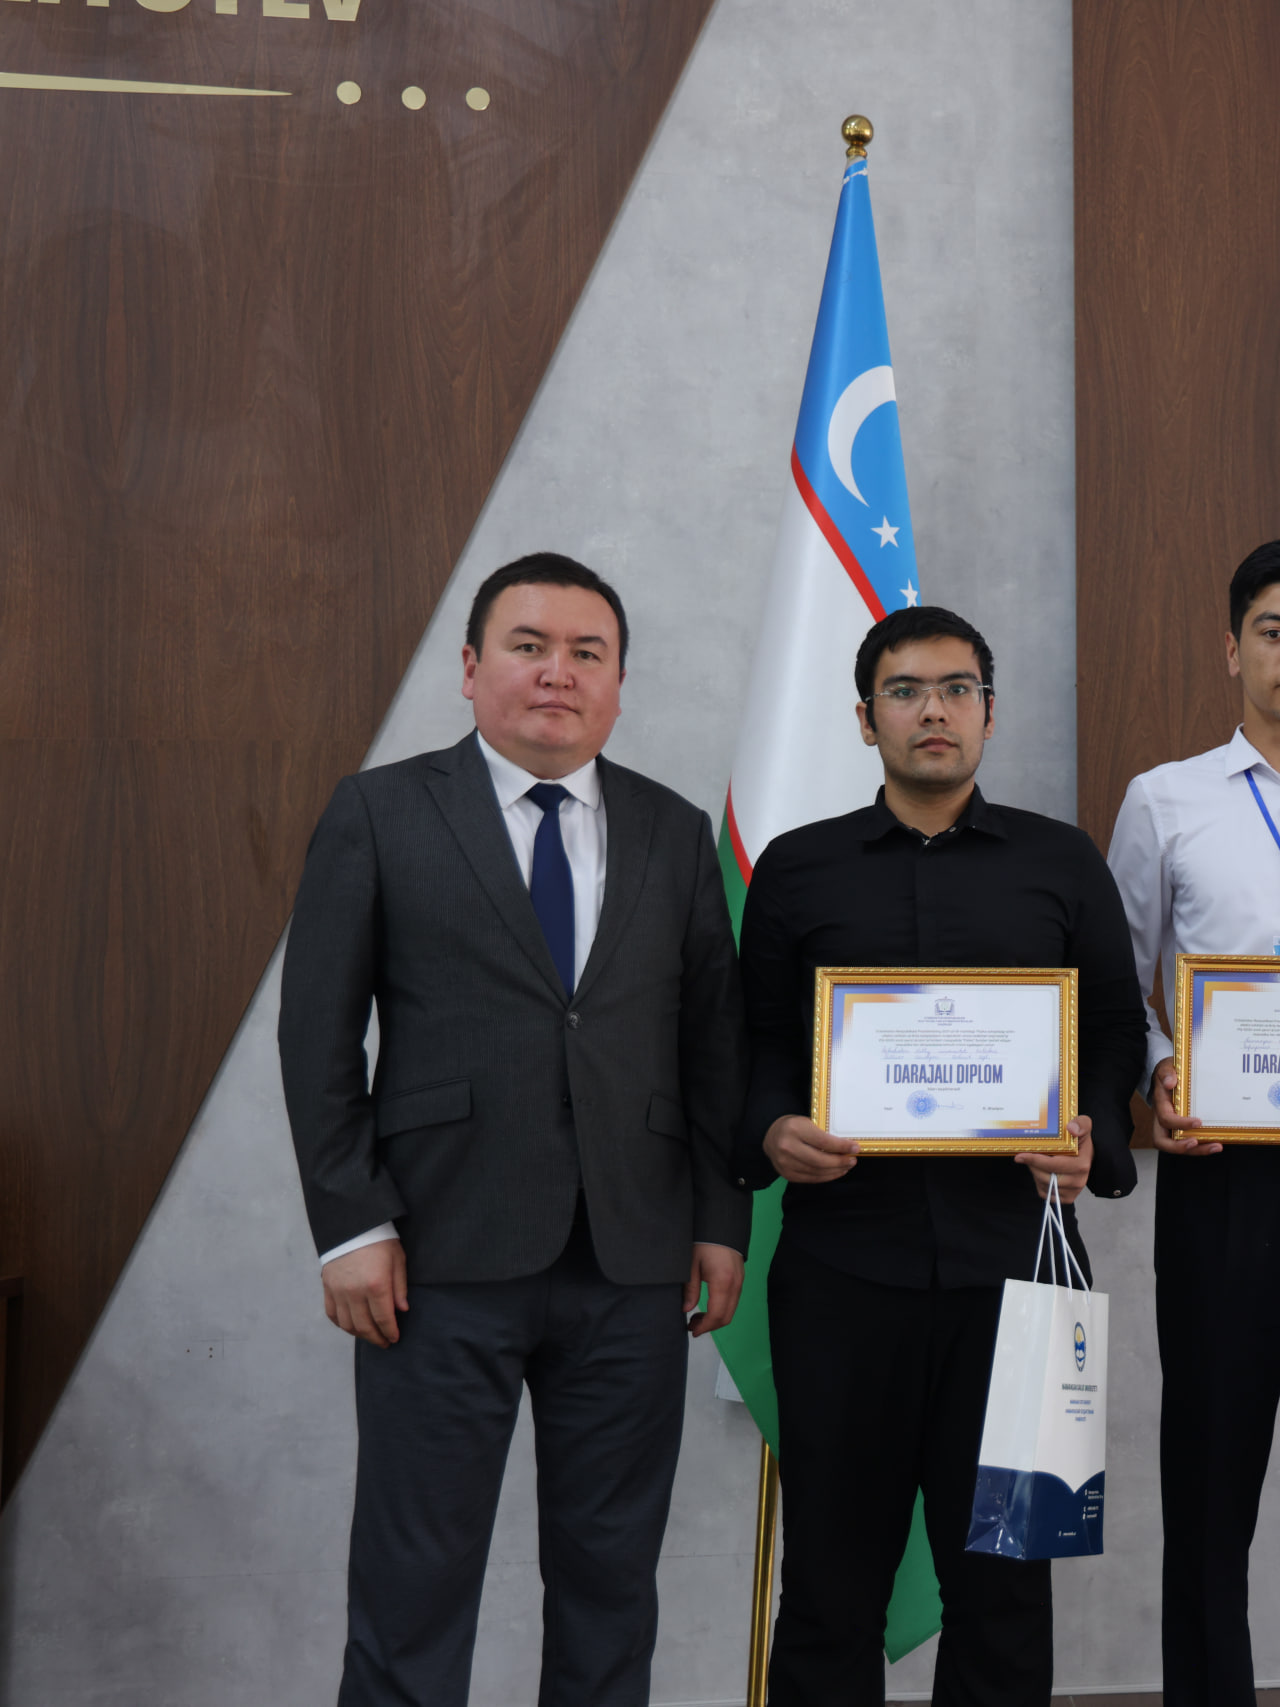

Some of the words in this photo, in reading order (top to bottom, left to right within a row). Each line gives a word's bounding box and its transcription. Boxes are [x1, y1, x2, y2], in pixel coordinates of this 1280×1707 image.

[1242, 1053, 1251, 1074] II
[886, 1064, 890, 1083] I
[893, 1064, 953, 1084] DARAJALI
[956, 1064, 1003, 1084] DIPLOM
